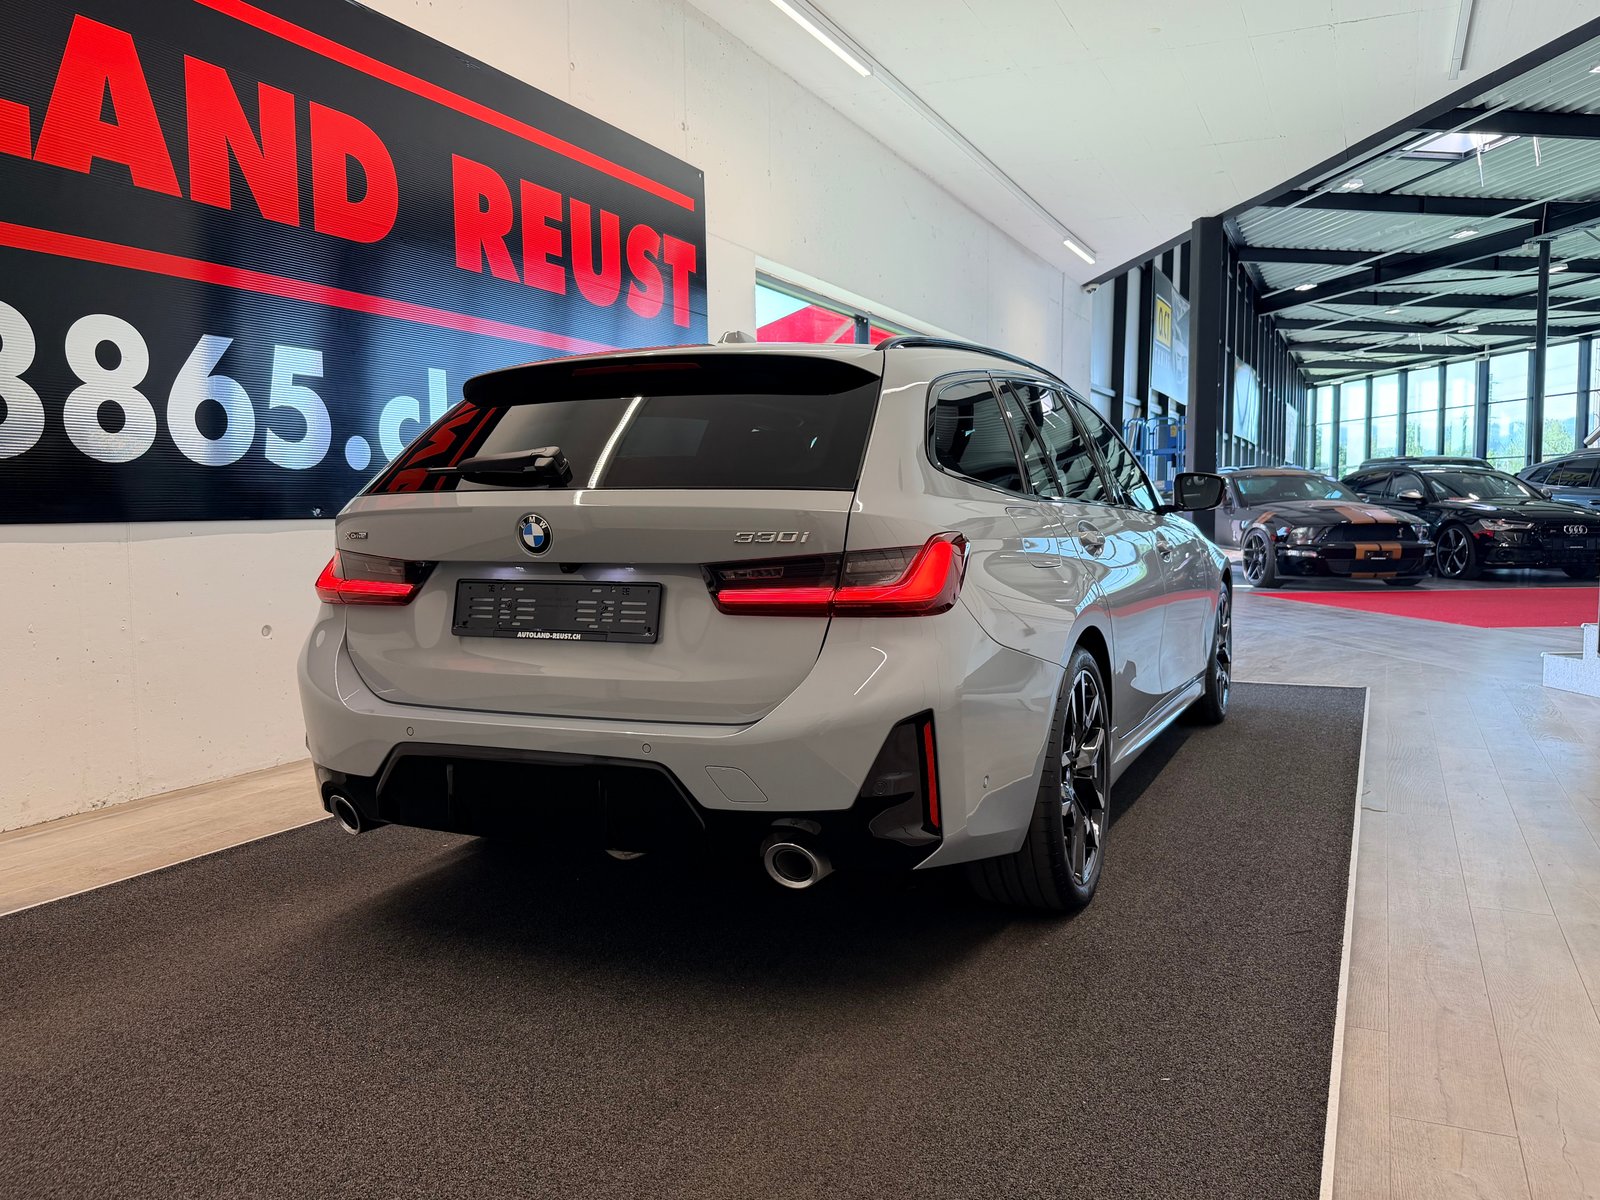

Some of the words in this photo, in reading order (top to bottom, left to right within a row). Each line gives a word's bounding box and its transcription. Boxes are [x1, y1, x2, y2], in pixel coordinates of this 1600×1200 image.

[451, 152, 696, 329] REUST
[734, 531, 810, 543] 330i
[517, 631, 581, 641] AUTOLAND-REUST.CH
